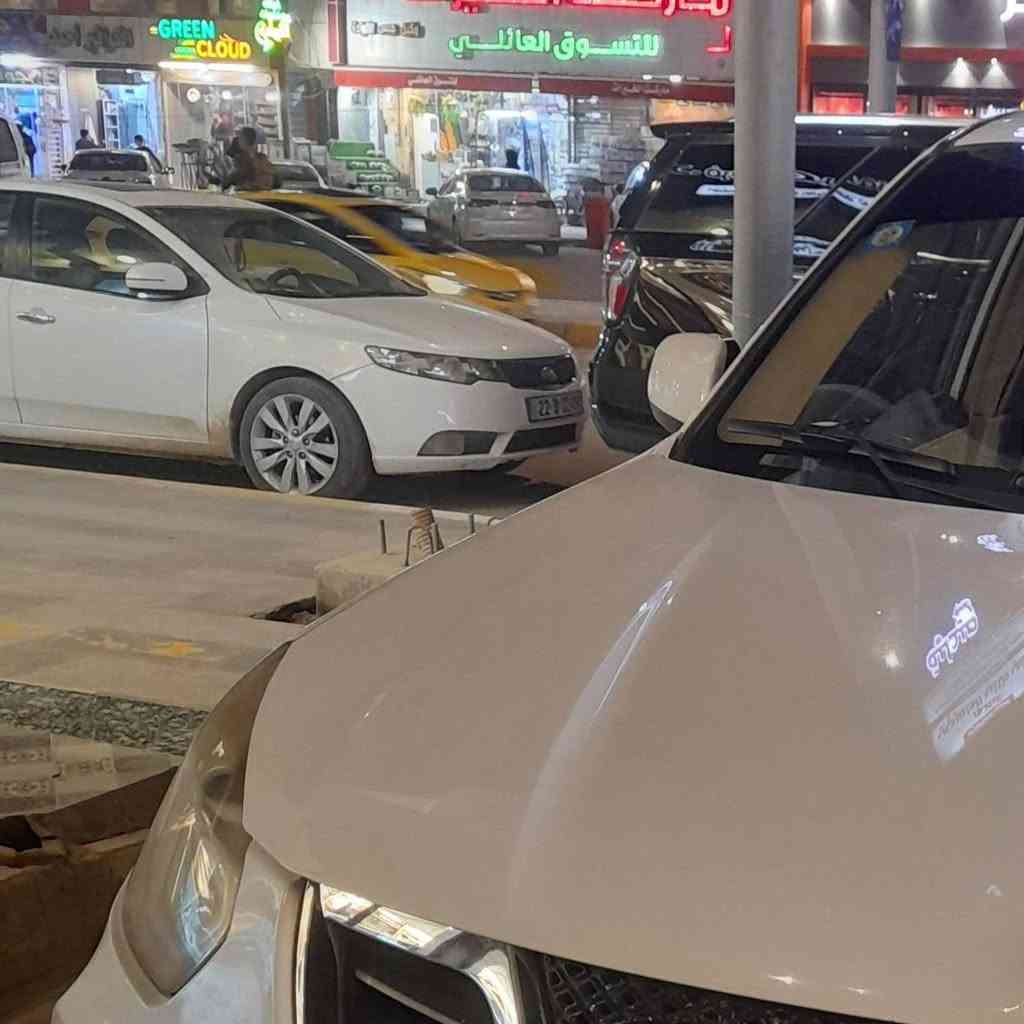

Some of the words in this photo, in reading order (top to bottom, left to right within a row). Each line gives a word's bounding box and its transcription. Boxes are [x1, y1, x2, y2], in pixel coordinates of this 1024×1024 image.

[158, 19, 214, 39] GREEN
[196, 40, 251, 60] CLOUD
[447, 27, 550, 59] العائلي
[553, 31, 660, 61] للتسوق
